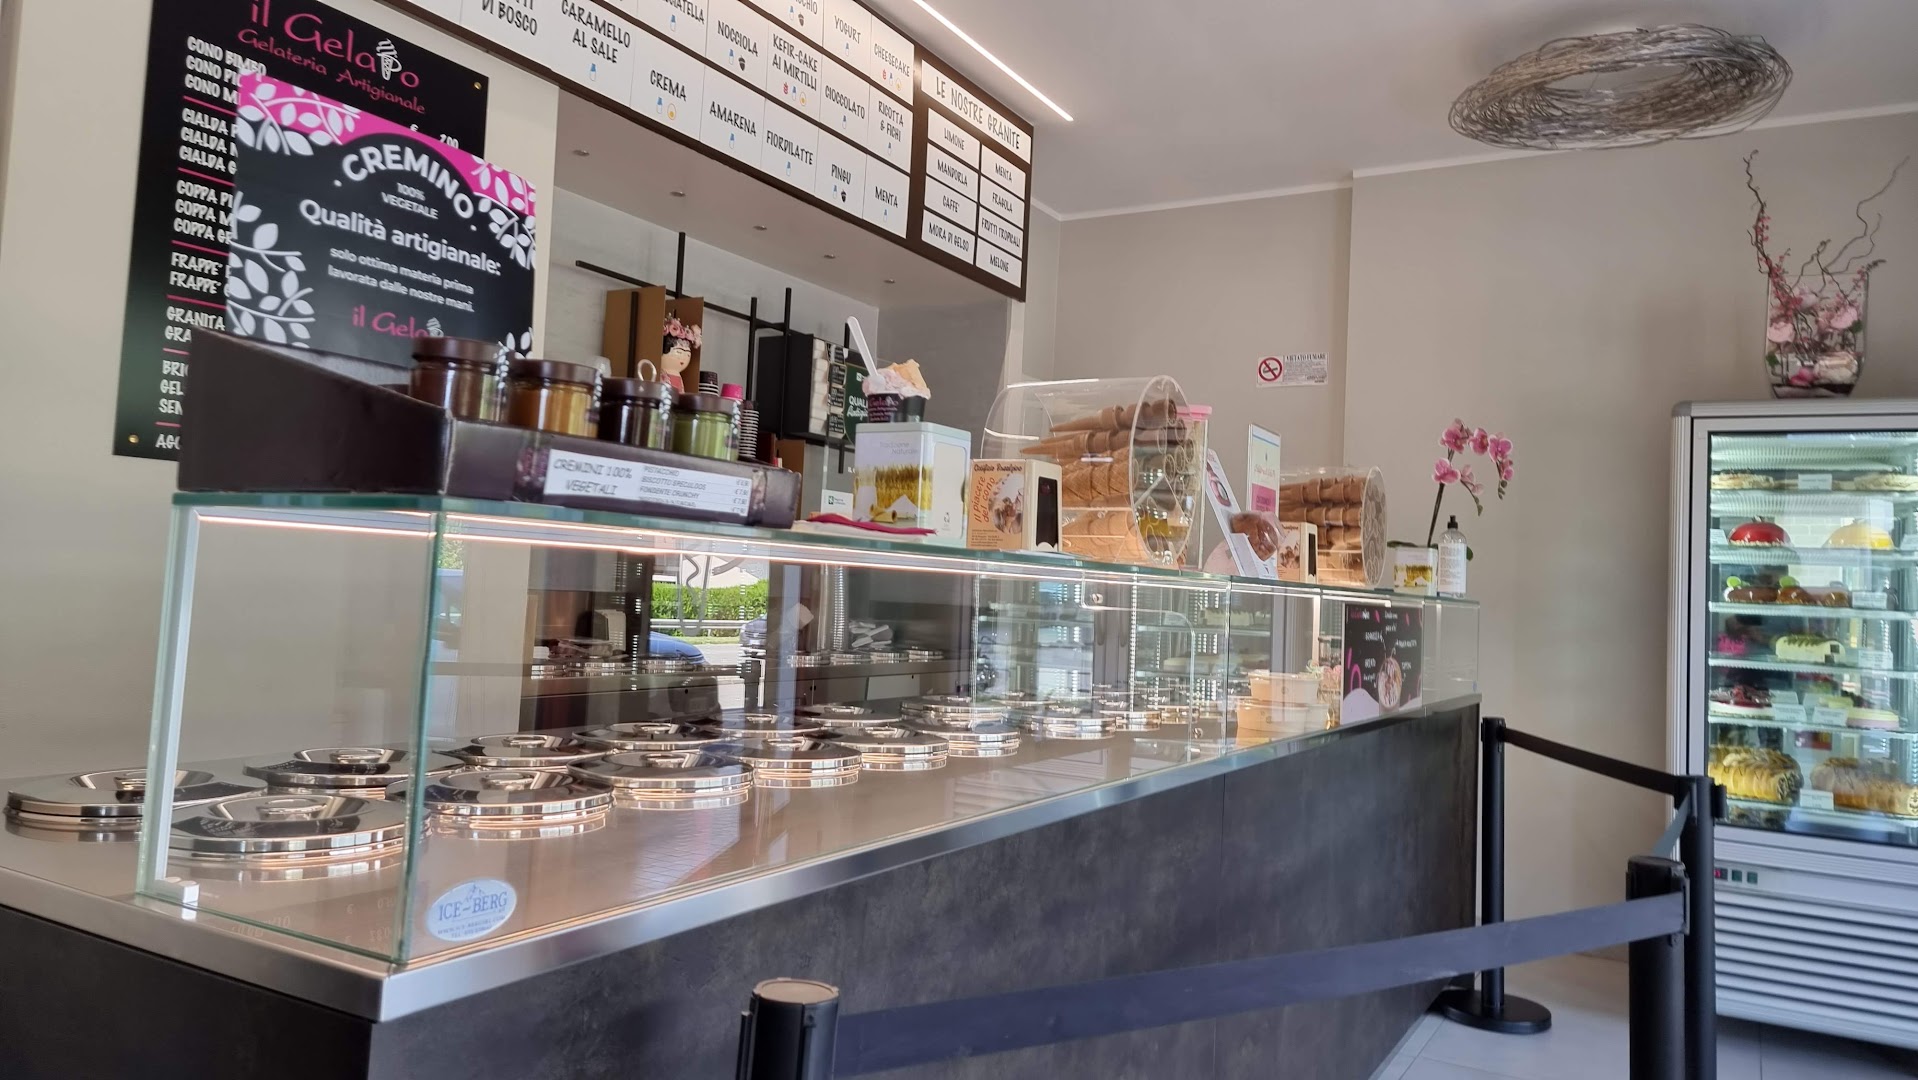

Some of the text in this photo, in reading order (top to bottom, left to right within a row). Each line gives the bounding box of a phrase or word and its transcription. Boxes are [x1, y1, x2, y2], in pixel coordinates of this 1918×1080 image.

[498, 1, 538, 36] BOSCO
[561, 0, 631, 48] CARAMELLO
[834, 15, 862, 44] YOGURT
[187, 36, 223, 61] CONO
[572, 28, 618, 64] AL SALE
[717, 20, 758, 57] NOCCIOLA
[186, 55, 222, 79] CONO
[772, 33, 818, 73] KEFIR-CAKE
[874, 43, 911, 78] CHEESECAKE
[237, 28, 426, 115] Gelateria Artigianale
[650, 69, 687, 102] CREMA
[772, 54, 818, 92] AI MIRTILLI
[185, 74, 221, 99] CONO
[825, 85, 865, 120] CIOCCOLATO
[878, 100, 904, 127] RICOTTA
[936, 76, 1020, 151] LE NOSTRE GRANITE
[182, 108, 228, 136] CIALDA
[709, 101, 757, 137] AMARENA
[886, 123, 902, 143] FICHI
[180, 127, 227, 154] CIALDA
[766, 130, 814, 165] FIORDILATTE
[944, 127, 965, 151] LIMONE
[179, 145, 226, 173] CIALDA
[937, 159, 968, 187] MANDORLA
[995, 162, 1013, 183] MENTA
[342, 144, 474, 219] CREMINO
[831, 163, 852, 186] PINGU
[176, 180, 218, 204] COPPA
[397, 182, 426, 201] 100%
[875, 186, 899, 208] MENTA
[992, 192, 1013, 214] FRAGOLA
[175, 199, 216, 222] COPPA
[381, 192, 439, 220] VEGETALE
[173, 217, 215, 241] COPPA
[299, 199, 501, 276] Qualità artigianale:
[929, 222, 947, 241] MORA
[954, 235, 970, 253] GELSO
[981, 217, 1021, 249] FRUTTI TROPICALI
[171, 252, 224, 275] FRAPPE'
[330, 248, 474, 297] solo ottima materia prima
[990, 253, 1009, 273] MELONE
[169, 271, 222, 294] FRAPPE'
[328, 264, 475, 313] lavorata dalle nostre mani.
[166, 306, 226, 331] GRANITA
[352, 304, 366, 328] il
[553, 458, 633, 479] CREMINI 100%
[565, 480, 618, 496] VEGETALI
[438, 891, 508, 921] ICE-BERG
